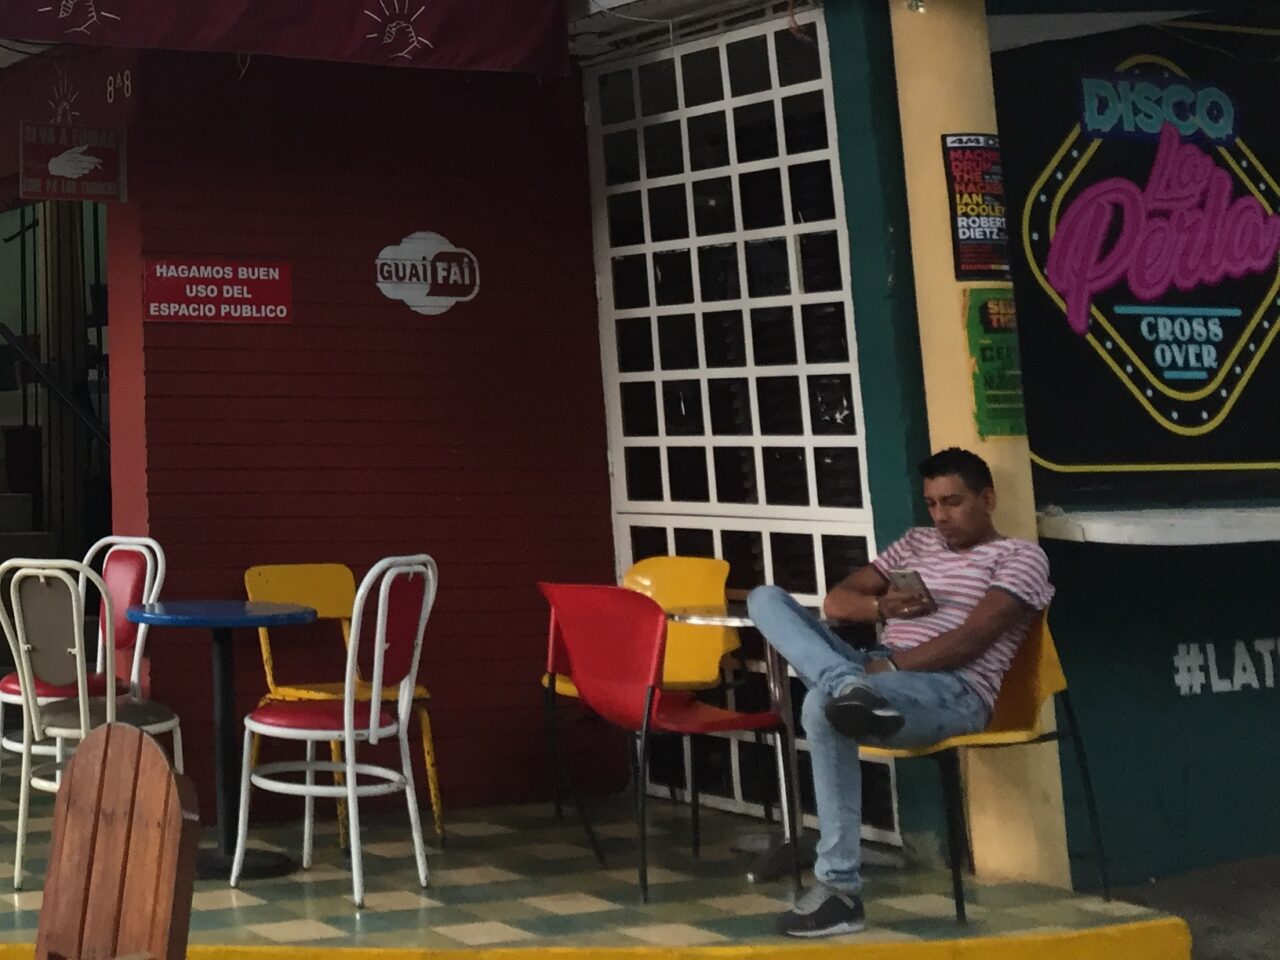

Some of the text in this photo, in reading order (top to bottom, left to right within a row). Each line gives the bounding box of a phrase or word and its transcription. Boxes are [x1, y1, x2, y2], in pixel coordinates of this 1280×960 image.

[1081, 77, 1236, 140] DISCO
[956, 193, 982, 205] IAN
[959, 228, 1000, 240] DIETZ
[1046, 165, 1280, 336] Perla
[155, 264, 280, 281] HAGAMOS BUEN
[185, 284, 252, 299] USO DEL
[149, 303, 288, 318] ESPACIO PUBLICO
[1140, 316, 1224, 342] CROSS
[1153, 342, 1219, 369] OVER
[1172, 637, 1280, 696] #LAT
